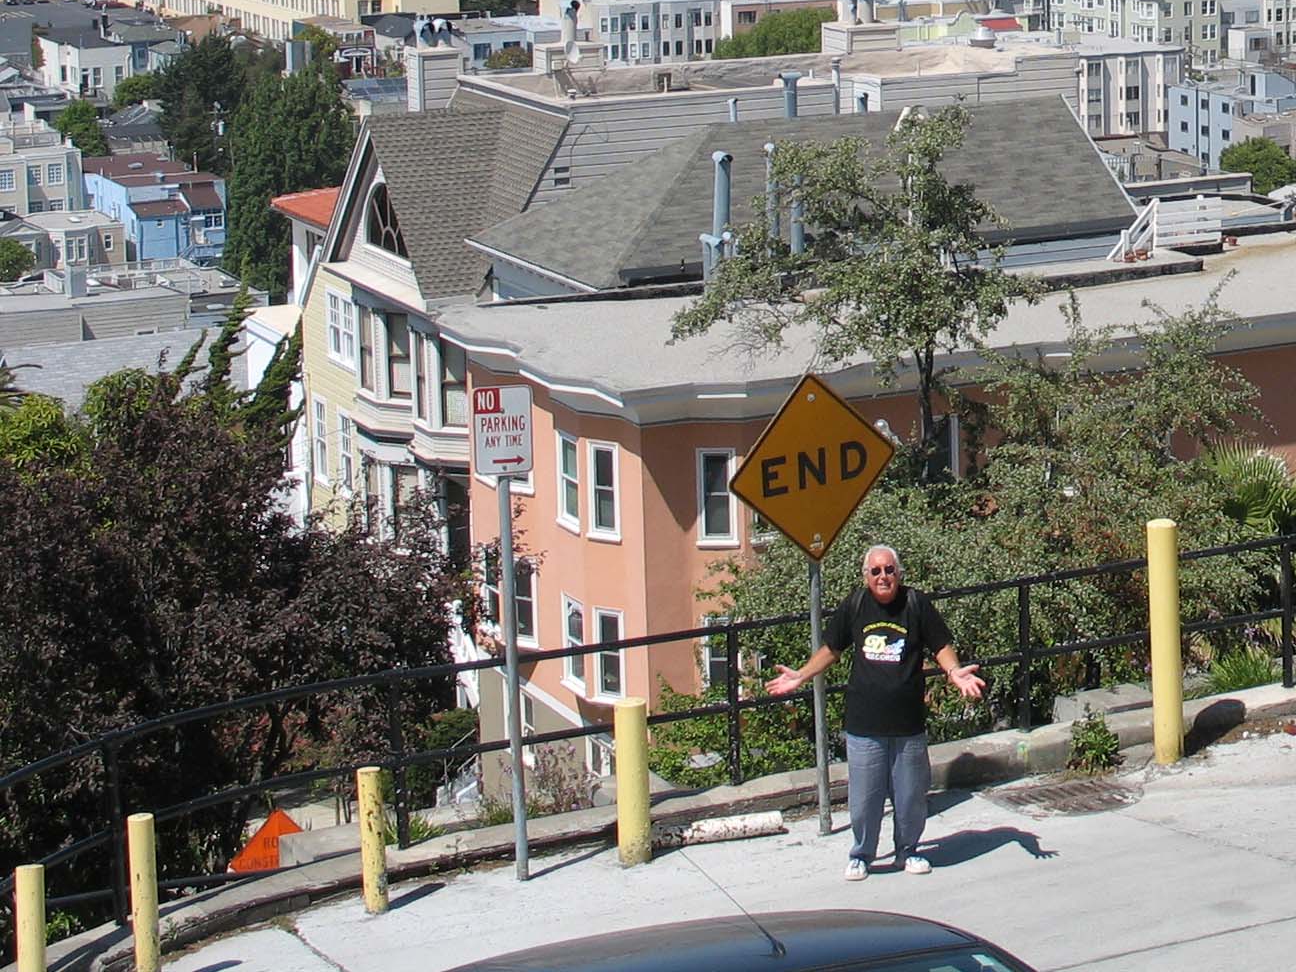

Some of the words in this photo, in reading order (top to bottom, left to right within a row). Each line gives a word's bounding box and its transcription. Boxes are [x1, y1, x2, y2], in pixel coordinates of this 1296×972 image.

[477, 390, 494, 411] NO
[480, 415, 526, 433] PARKING
[485, 435, 501, 448] ANY
[505, 434, 523, 447] TIME
[760, 440, 868, 498] END
[263, 836, 278, 849] RO
